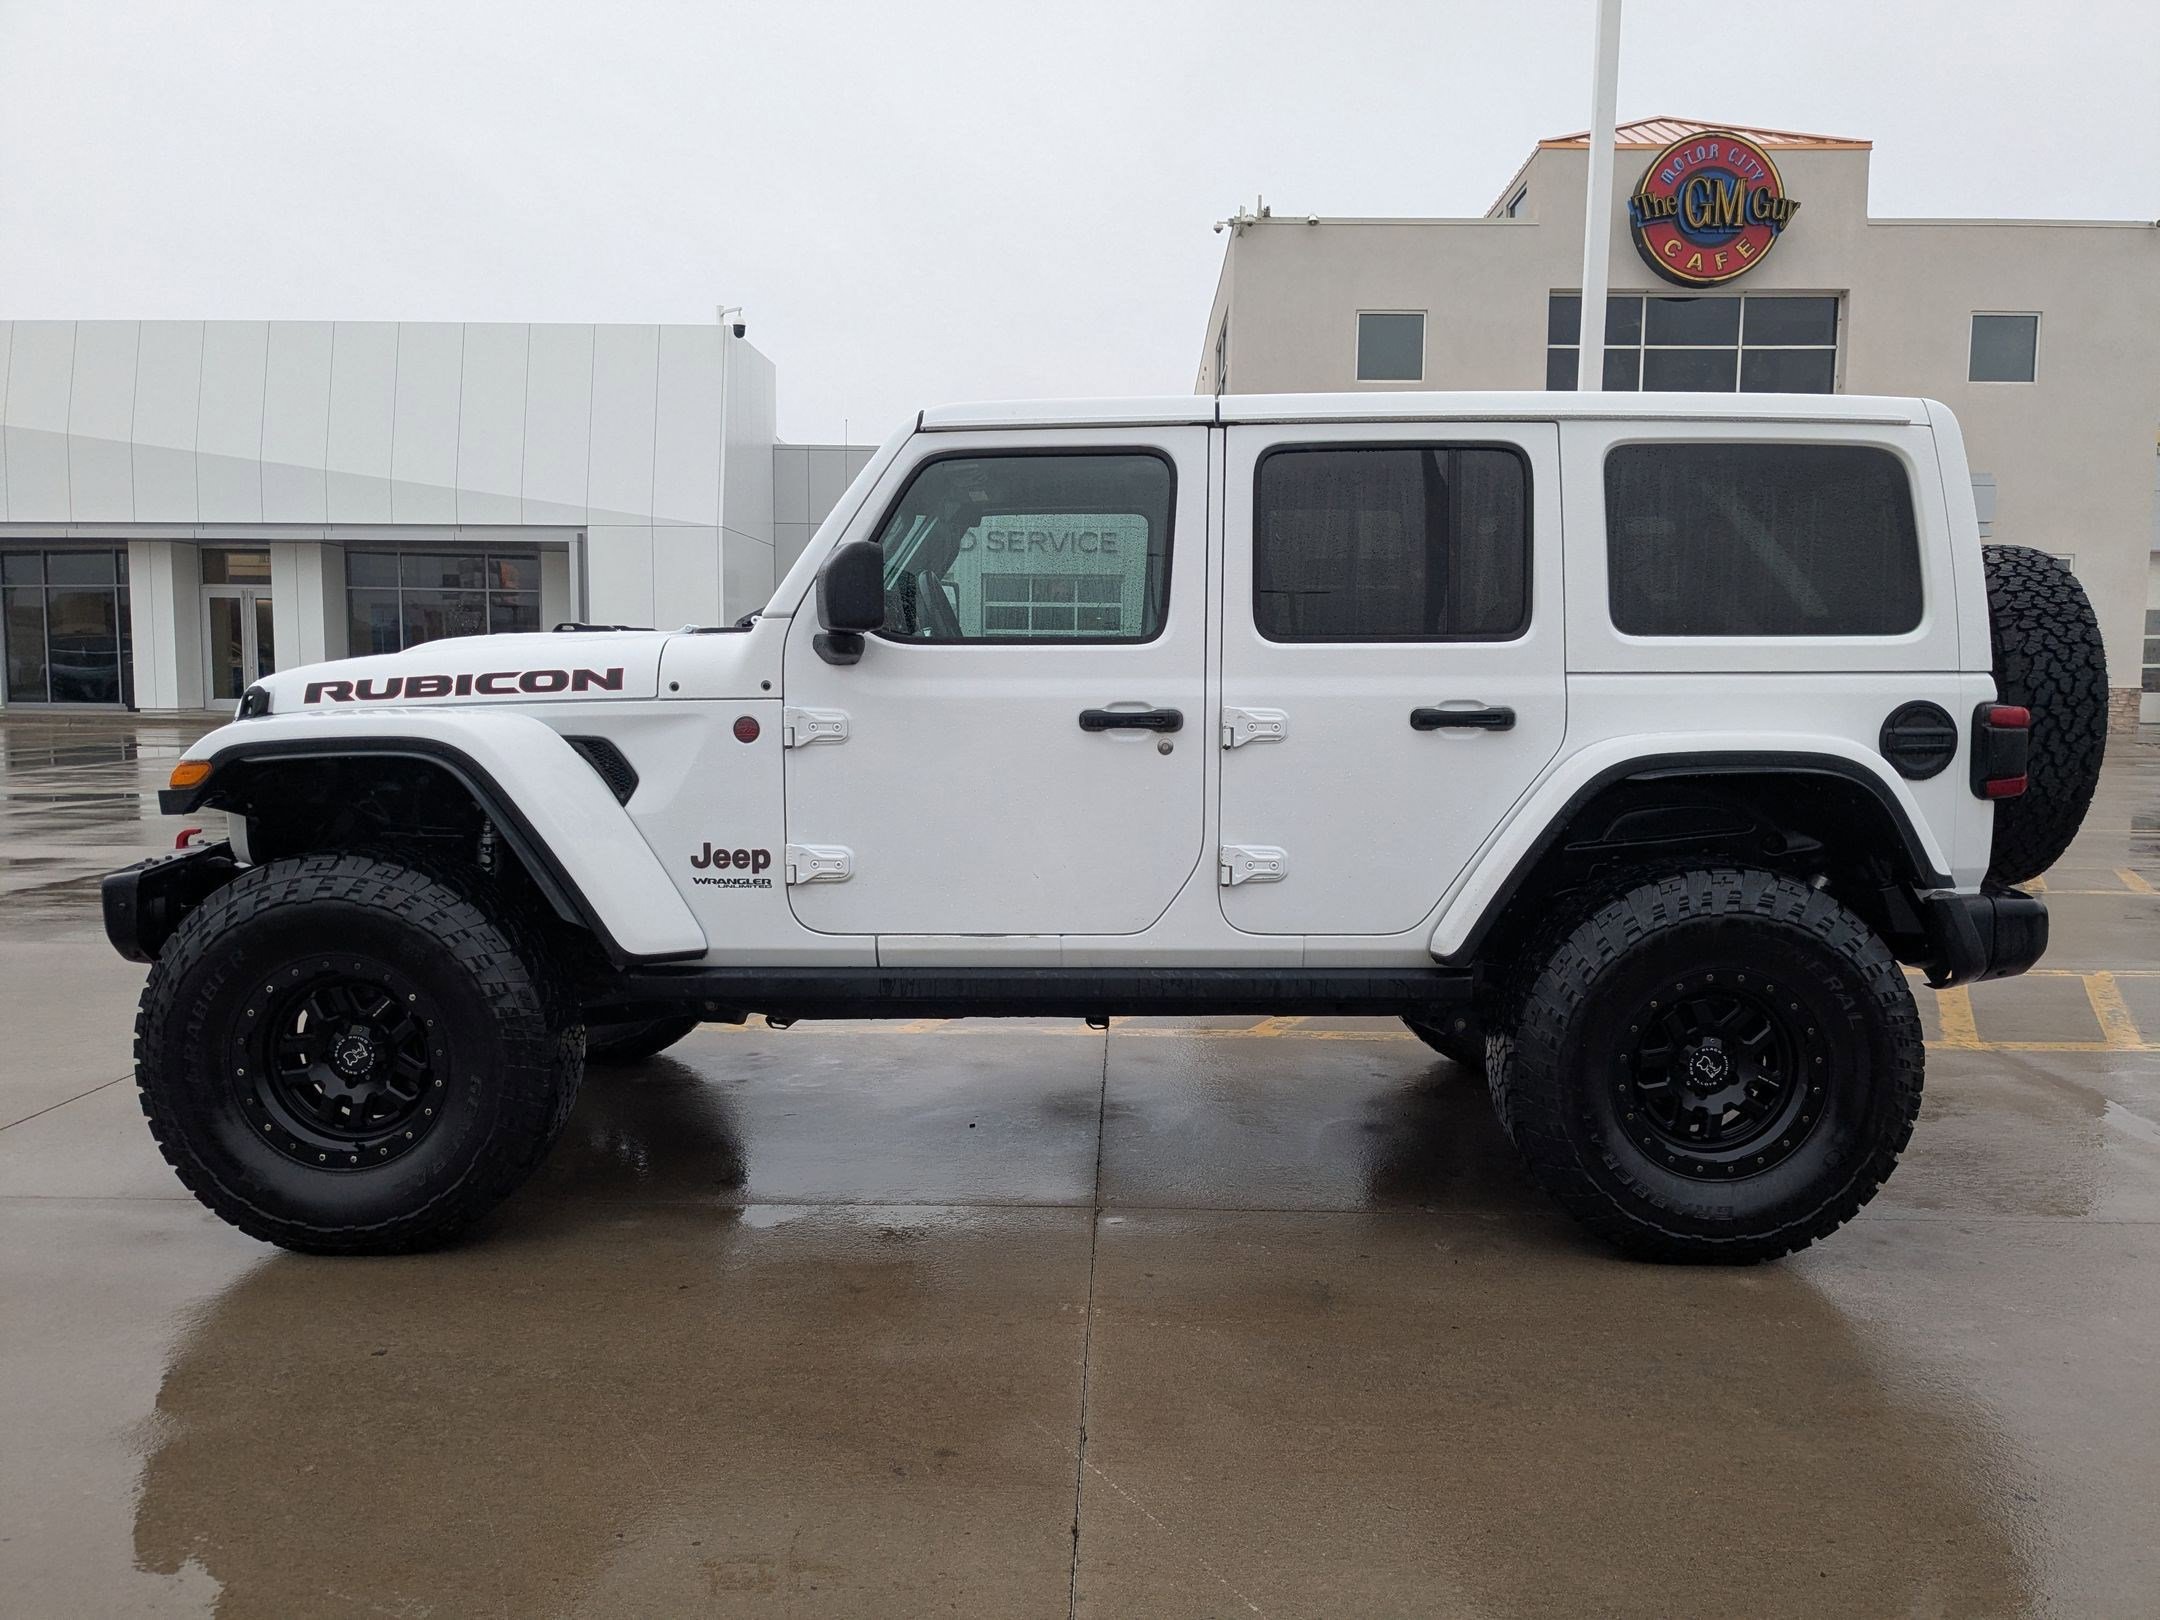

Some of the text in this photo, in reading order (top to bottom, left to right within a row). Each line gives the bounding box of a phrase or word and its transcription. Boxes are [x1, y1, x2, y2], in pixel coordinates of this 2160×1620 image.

[1660, 143, 1765, 185] MOTOR CITY
[1632, 176, 1802, 230] The GM Guy
[1664, 238, 1756, 271] CAFE
[987, 531, 1118, 553] SERVICE
[303, 667, 625, 704] RUBICON
[690, 842, 771, 874] Jeep
[692, 877, 772, 885] WRANGLER
